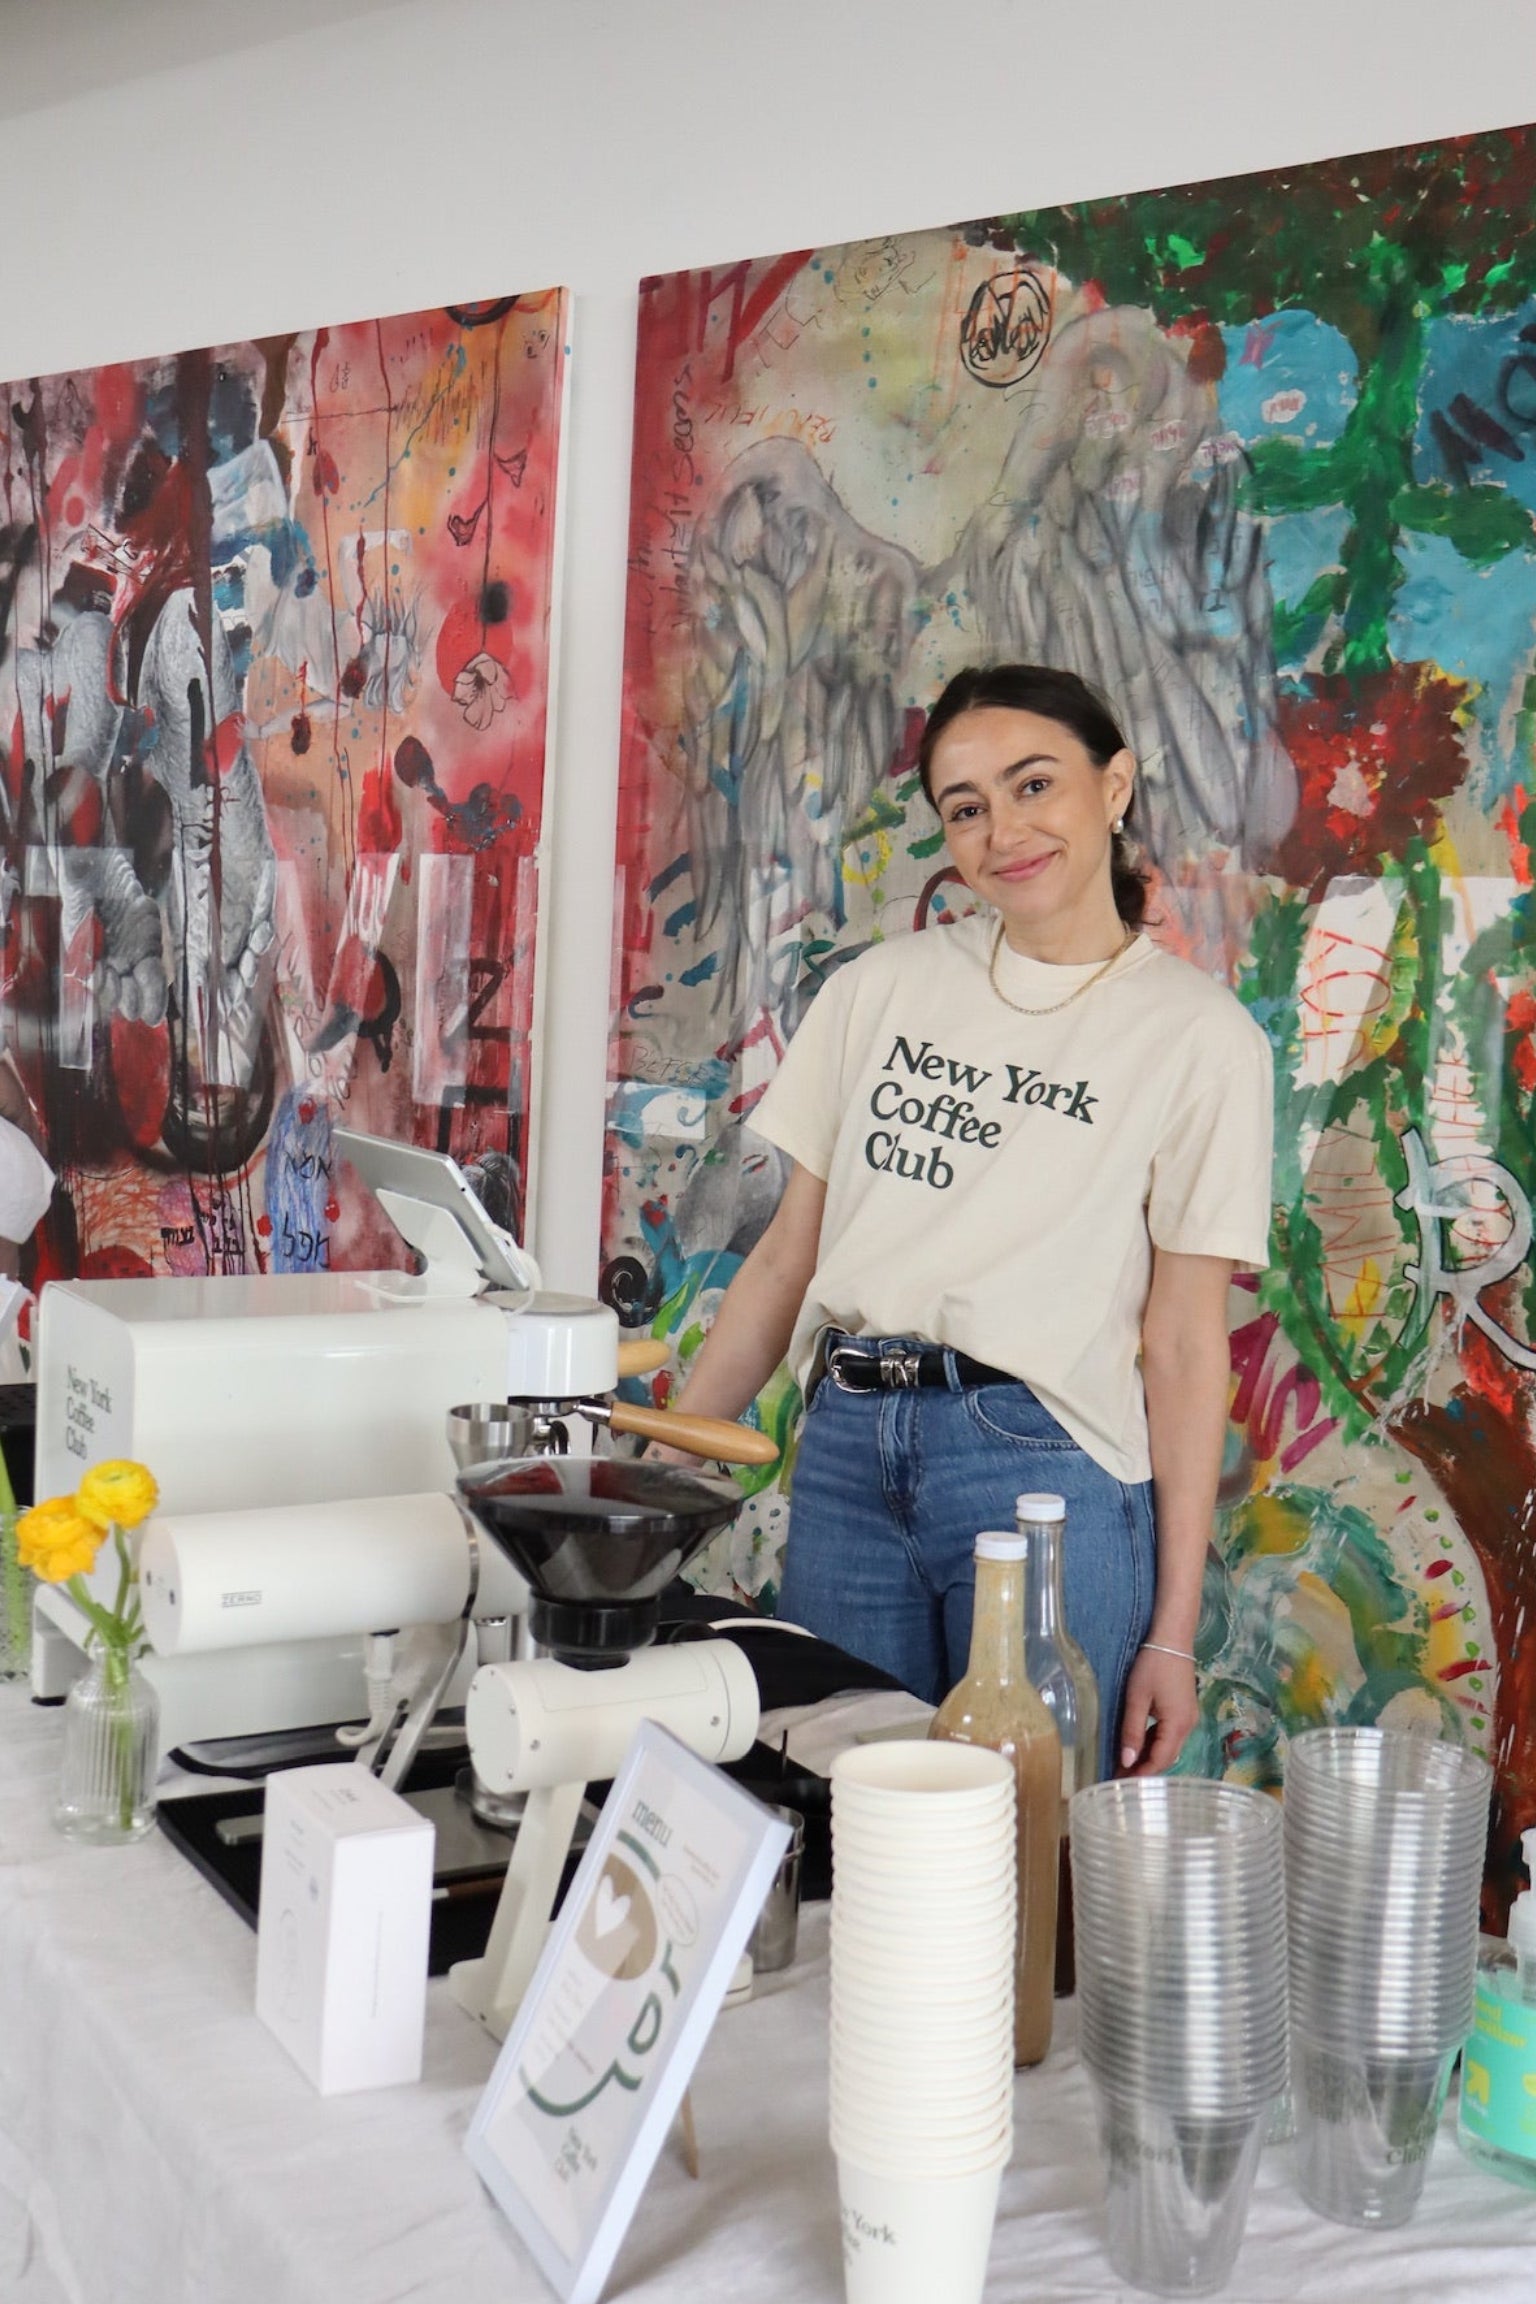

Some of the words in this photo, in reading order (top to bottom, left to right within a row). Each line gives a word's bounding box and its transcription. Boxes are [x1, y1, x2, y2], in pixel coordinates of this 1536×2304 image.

[882, 1036, 992, 1093] New
[1002, 1064, 1099, 1124] York
[871, 1081, 1002, 1149] Coffee
[865, 1131, 954, 1189] Club
[66, 1364, 88, 1397] New
[89, 1378, 112, 1414] York
[66, 1396, 95, 1433] Coffee
[66, 1425, 88, 1460] Club
[632, 1801, 673, 1848] menu
[851, 2208, 897, 2246] York
